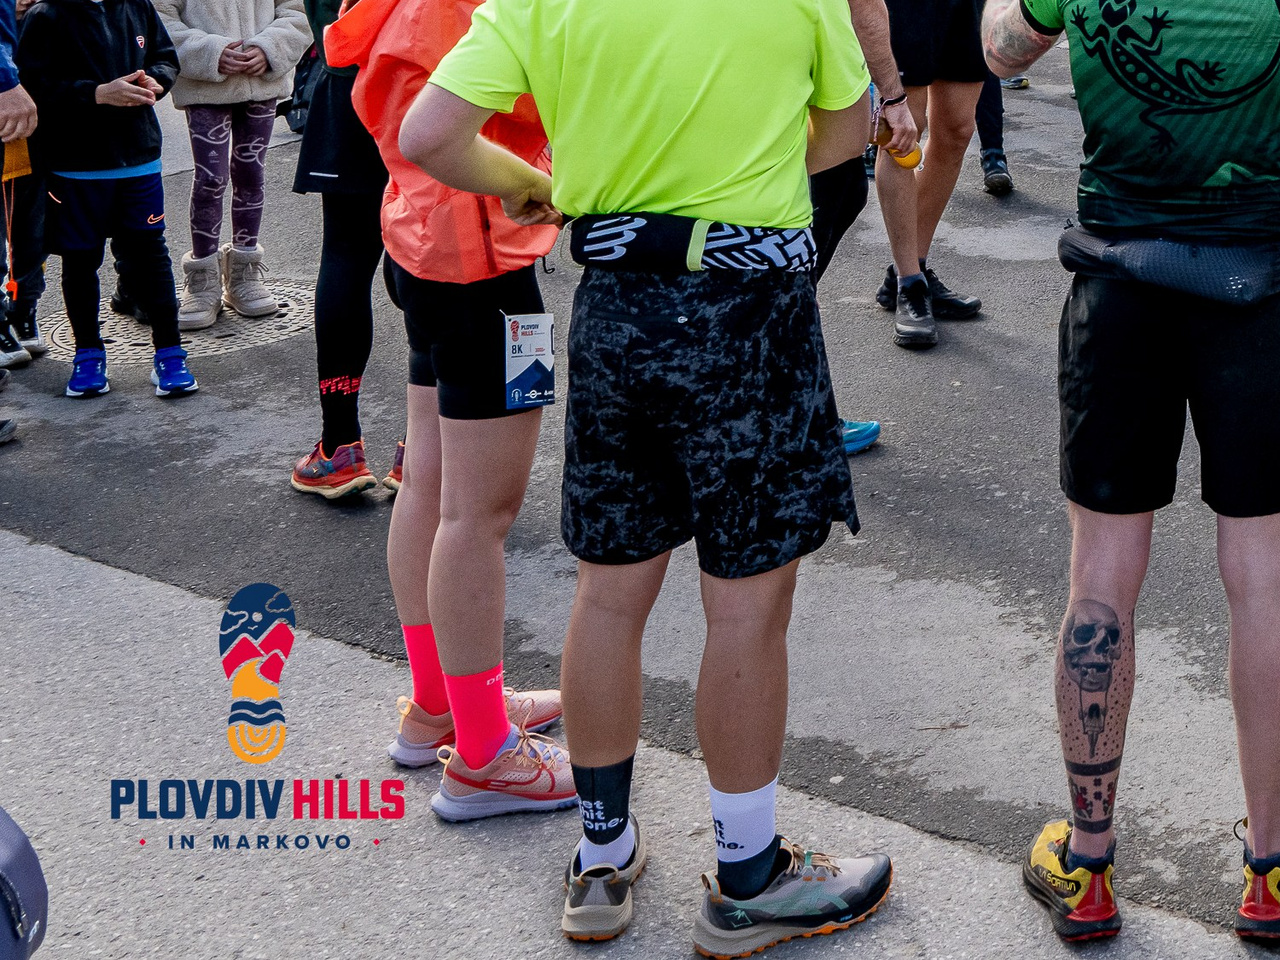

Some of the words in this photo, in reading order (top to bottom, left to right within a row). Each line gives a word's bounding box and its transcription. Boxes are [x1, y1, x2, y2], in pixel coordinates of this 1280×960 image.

[511, 344, 523, 355] 8K
[579, 809, 606, 820] hit
[582, 818, 624, 831] one.
